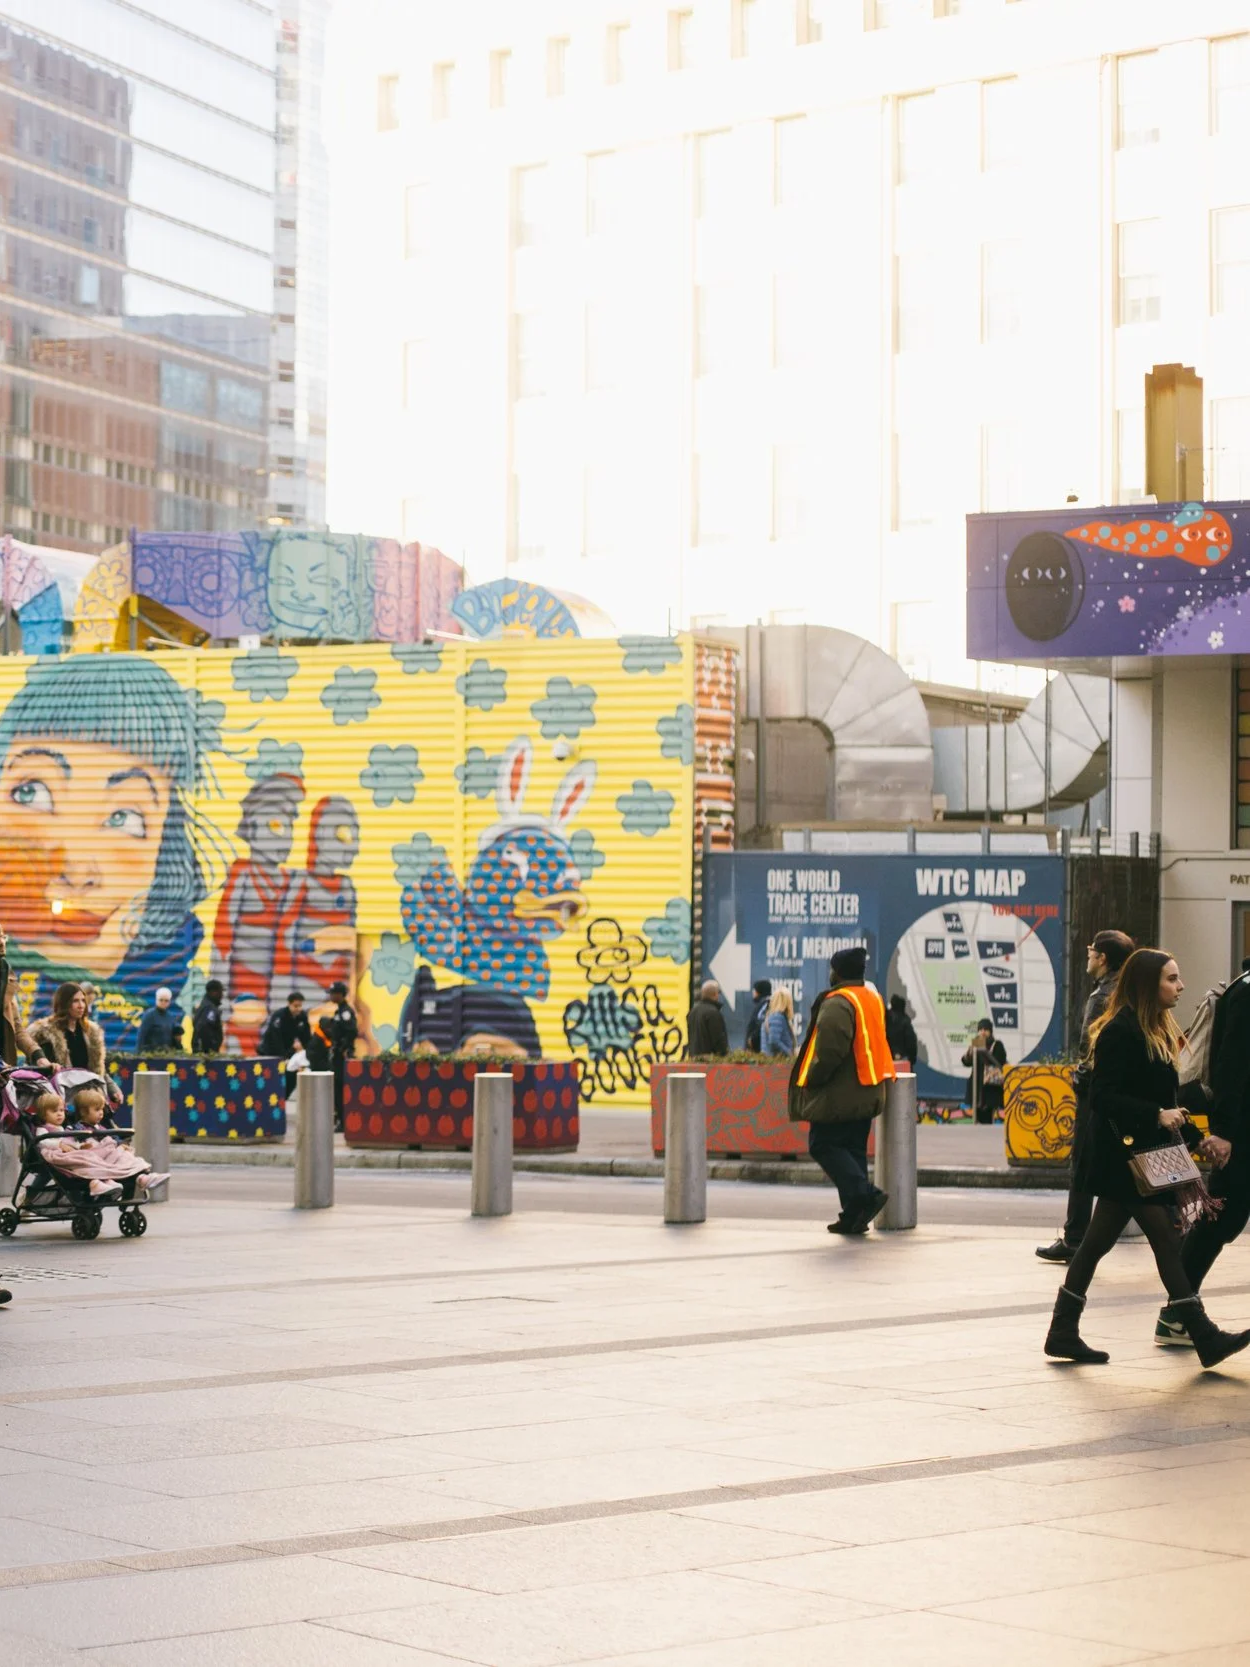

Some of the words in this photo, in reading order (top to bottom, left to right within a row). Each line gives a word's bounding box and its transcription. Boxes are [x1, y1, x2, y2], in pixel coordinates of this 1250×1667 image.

[767, 869, 793, 891] ONE
[796, 869, 840, 892] WORLD
[915, 868, 969, 896] WTC
[974, 868, 1026, 896] MAP
[767, 893, 807, 915] TRADE
[810, 893, 859, 916] CENTER
[992, 904, 1012, 917] YOU
[1014, 904, 1033, 917] ARE
[1034, 904, 1059, 917] HERE
[766, 935, 797, 959] 9/11
